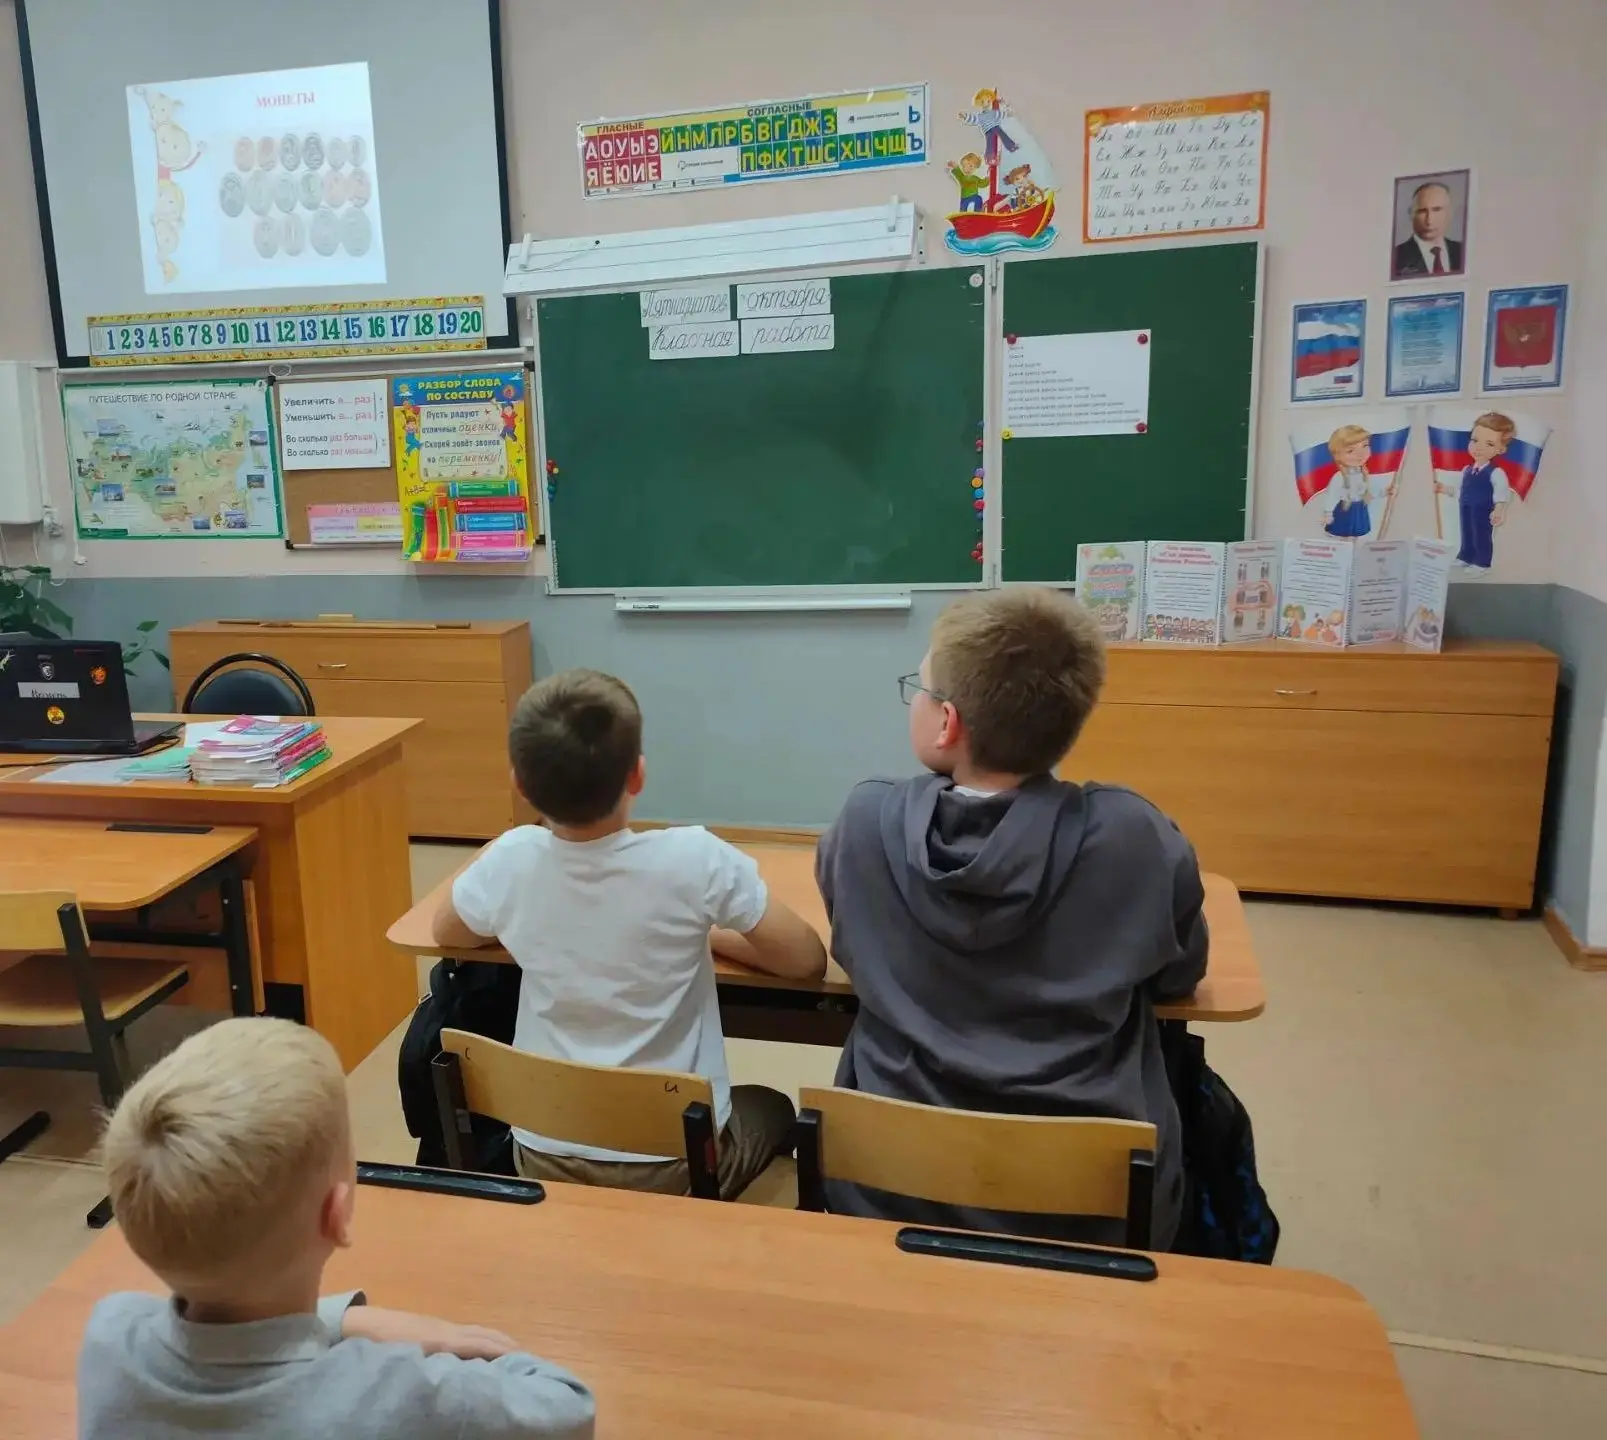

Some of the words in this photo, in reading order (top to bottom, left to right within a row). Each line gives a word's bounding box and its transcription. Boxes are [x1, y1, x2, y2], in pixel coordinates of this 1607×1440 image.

[747, 101, 812, 117] СОГЛАСНЫЕ
[597, 122, 645, 134] ГЛАСНЫЕ
[107, 328, 116, 350] 1
[120, 329, 131, 350] 2
[134, 328, 145, 349] 3
[149, 327, 159, 348] 4
[161, 327, 171, 347] 5
[173, 325, 184, 347] 6
[188, 325, 198, 346] 7
[201, 323, 213, 345] 8
[216, 323, 227, 344] 9
[231, 322, 249, 344] 10
[254, 321, 271, 343] 11
[275, 320, 296, 343] 12
[299, 319, 318, 341] 13
[320, 318, 340, 340] 14
[344, 317, 362, 339] 15
[367, 316, 385, 338] 16
[390, 314, 409, 337] 17
[413, 313, 434, 336] 18
[437, 312, 458, 335] 19
[460, 310, 482, 334] 20
[751, 318, 831, 352] работа
[418, 380, 461, 390] РАЗБОР
[464, 378, 501, 388] СЛОВА
[89, 393, 148, 404] ПУТЕШЕСТВИЕ
[151, 393, 163, 402] ПО
[165, 391, 200, 402] РОДНОЙ
[203, 391, 237, 400] СТРАНЕ
[426, 392, 442, 401] ПО
[444, 390, 494, 400] СОСТАВУ
[284, 398, 335, 407] Увеличить
[354, 396, 371, 405] раз
[285, 413, 336, 421] Уменьшить
[426, 410, 448, 420] Пусть
[450, 410, 479, 420] радуют
[421, 426, 457, 434] отличные
[285, 434, 296, 443] Во
[287, 448, 297, 457] Во
